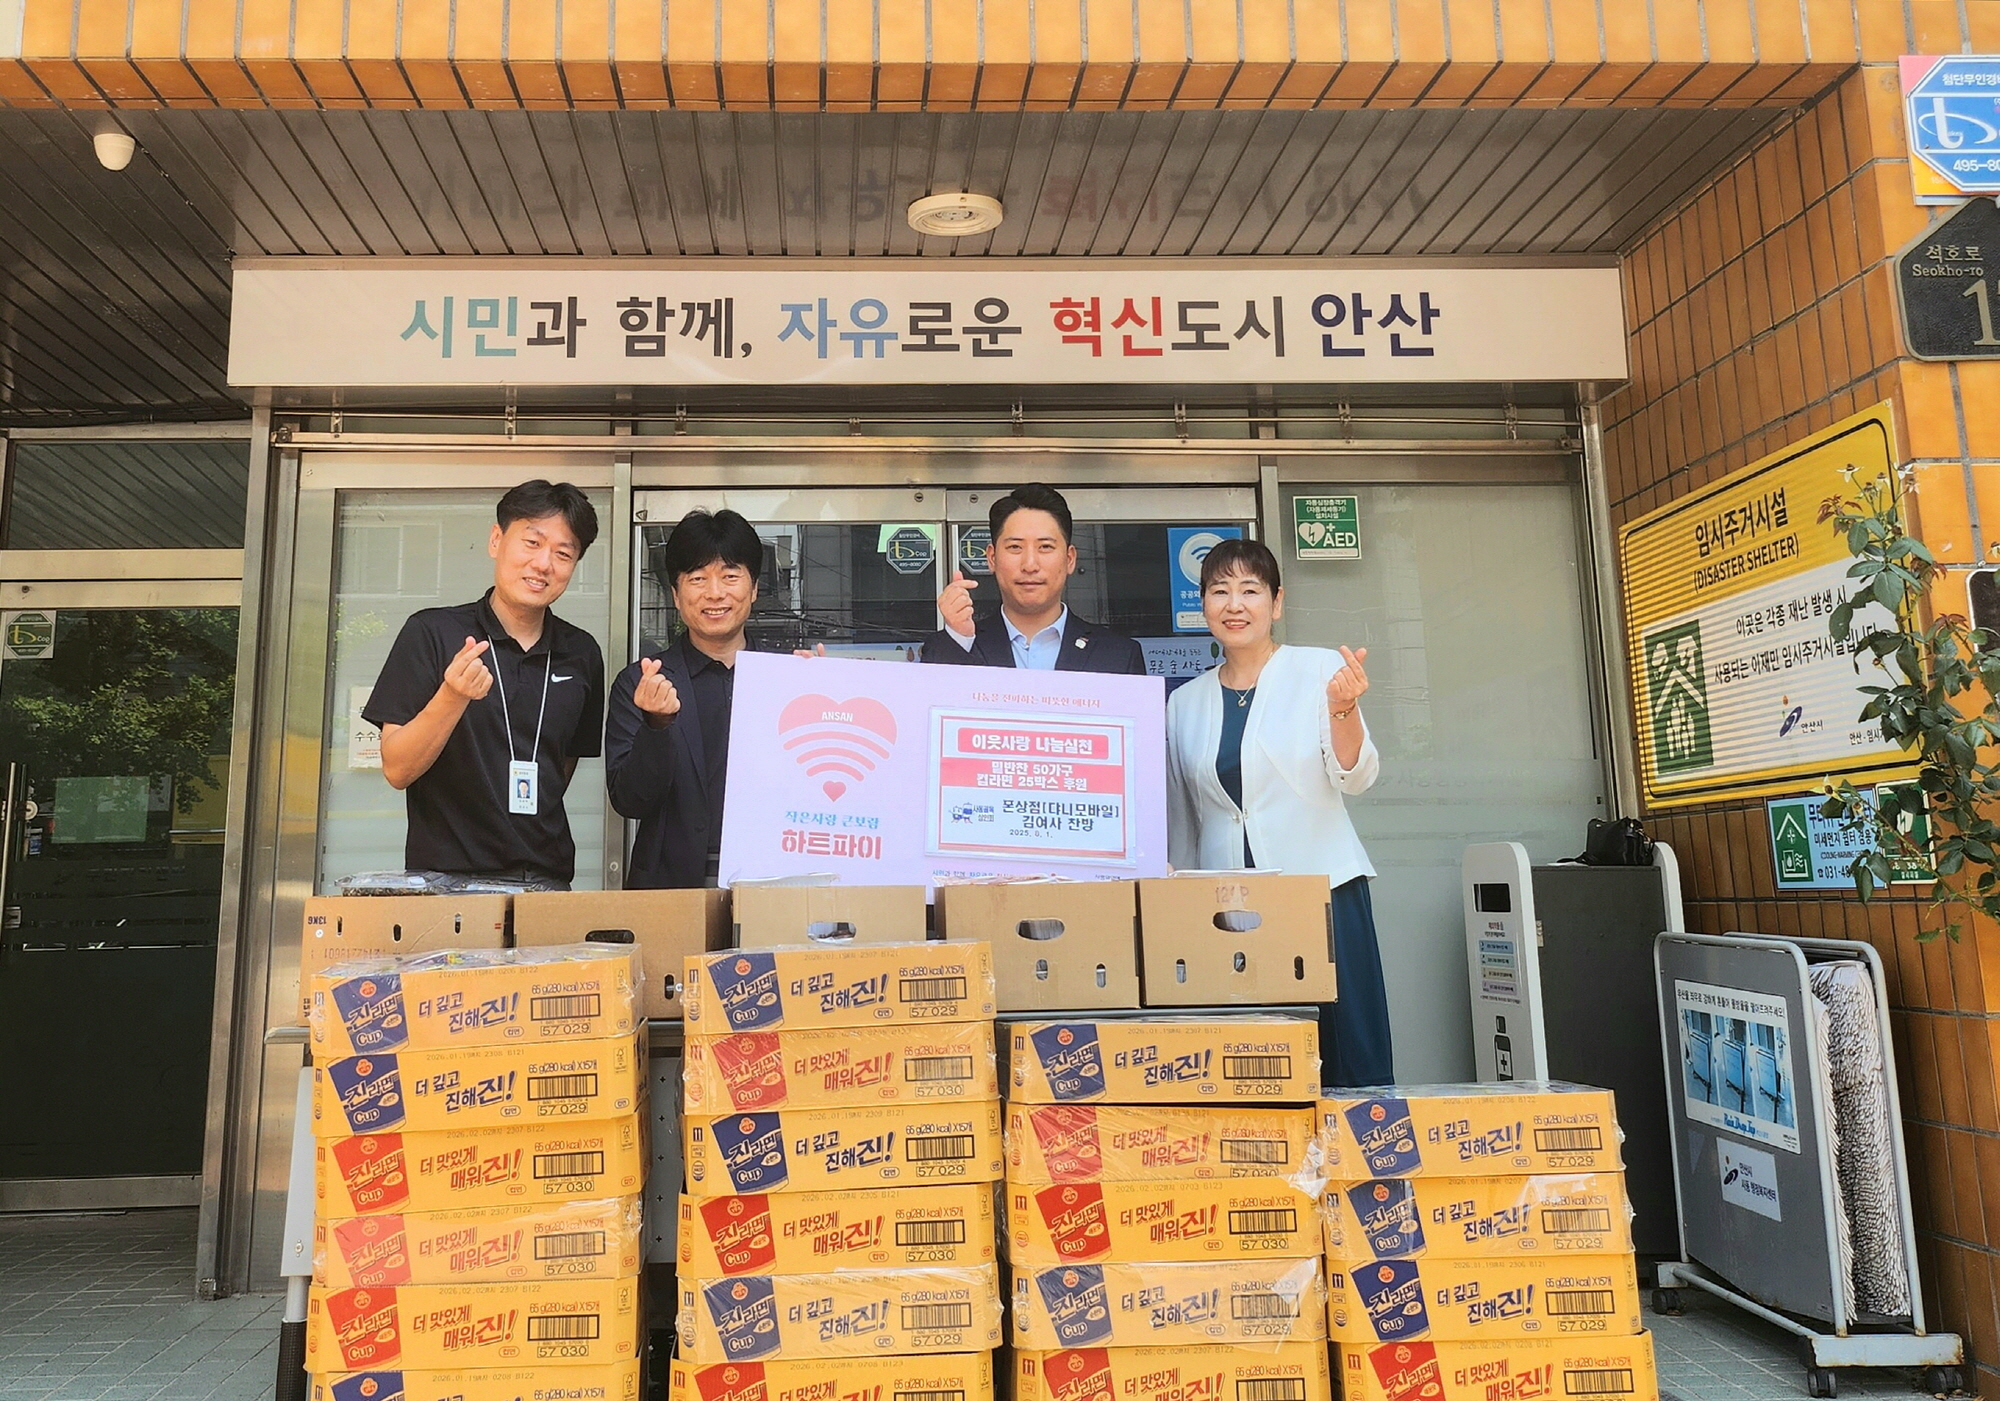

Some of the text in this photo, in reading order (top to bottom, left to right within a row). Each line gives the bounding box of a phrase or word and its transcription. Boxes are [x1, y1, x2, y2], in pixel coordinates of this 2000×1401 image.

[1942, 73, 2000, 86] 첨단무인경
[1925, 245, 1984, 262] 석호로
[1912, 264, 1984, 277] Seokho-ro
[400, 292, 1440, 358] 시민과 함께, 자유로운 혁신도시 안산
[1695, 487, 1788, 558] 임시주거시설
[1323, 532, 1357, 547] AED
[1694, 532, 1800, 594] (DISASTER SHELTER)
[1736, 584, 1847, 638] 이곳은 각종 재난 발생 시
[1714, 658, 1749, 684] 사용되는
[1751, 648, 1780, 676] 이재민
[821, 711, 854, 722] ANSAN
[1800, 719, 1824, 733] 안산시
[972, 734, 1093, 755] 이웃사랑 나눔실천
[976, 773, 1087, 791] 컵라면 25박스 후원
[1033, 763, 1073, 778] 50가구
[785, 810, 879, 830] 작은사랑 큰보람
[1022, 815, 1094, 832] 김여사 찬방
[781, 829, 882, 860] 하트파이
[1009, 829, 1032, 838] 2025.
[1814, 831, 1841, 848] 미세먼지
[1842, 830, 1857, 847] 쉼터
[791, 972, 833, 995] 더 깊고
[821, 975, 887, 1012] 진해진!
[420, 992, 463, 1016] 더 깊고
[450, 993, 518, 1031] 진해진!
[794, 1049, 848, 1074] 더 맛있게
[1116, 1045, 1157, 1066] 더 깊고
[1144, 1049, 1210, 1086] 진해진!
[416, 1071, 459, 1094] 더 깊고
[446, 1073, 514, 1111] 진해진!
[1057, 1078, 1081, 1092] Cup
[354, 1109, 379, 1123] Cup
[540, 1103, 586, 1115] 57 029
[797, 1130, 838, 1154] 더 깊고
[1428, 1119, 1470, 1142] 더 깊고
[1458, 1122, 1523, 1160] 진해진!
[421, 1147, 476, 1172] 더 맛있게
[827, 1133, 893, 1172] 진해진!
[451, 1150, 521, 1188] 매워진!
[357, 1189, 384, 1204] Cup
[1120, 1200, 1173, 1225] 더 맛있게
[1434, 1199, 1476, 1222] 더 깊고
[784, 1211, 838, 1237] 더 맛있게
[814, 1215, 882, 1254] 매워진!
[1149, 1204, 1217, 1242] 매워진!
[420, 1228, 475, 1255] 더 맛있게
[724, 1251, 750, 1266] Cup
[907, 1250, 954, 1262] 57 030
[1122, 1286, 1165, 1310] 더 깊고
[1438, 1282, 1480, 1304] 더 깊고
[1468, 1284, 1534, 1324] 진해진!
[414, 1304, 469, 1331] 더 맛있게
[790, 1298, 833, 1321] 더 깊고
[821, 1299, 888, 1340] 진해진!
[444, 1309, 515, 1349] 매워진!
[1380, 1318, 1404, 1332] Cup
